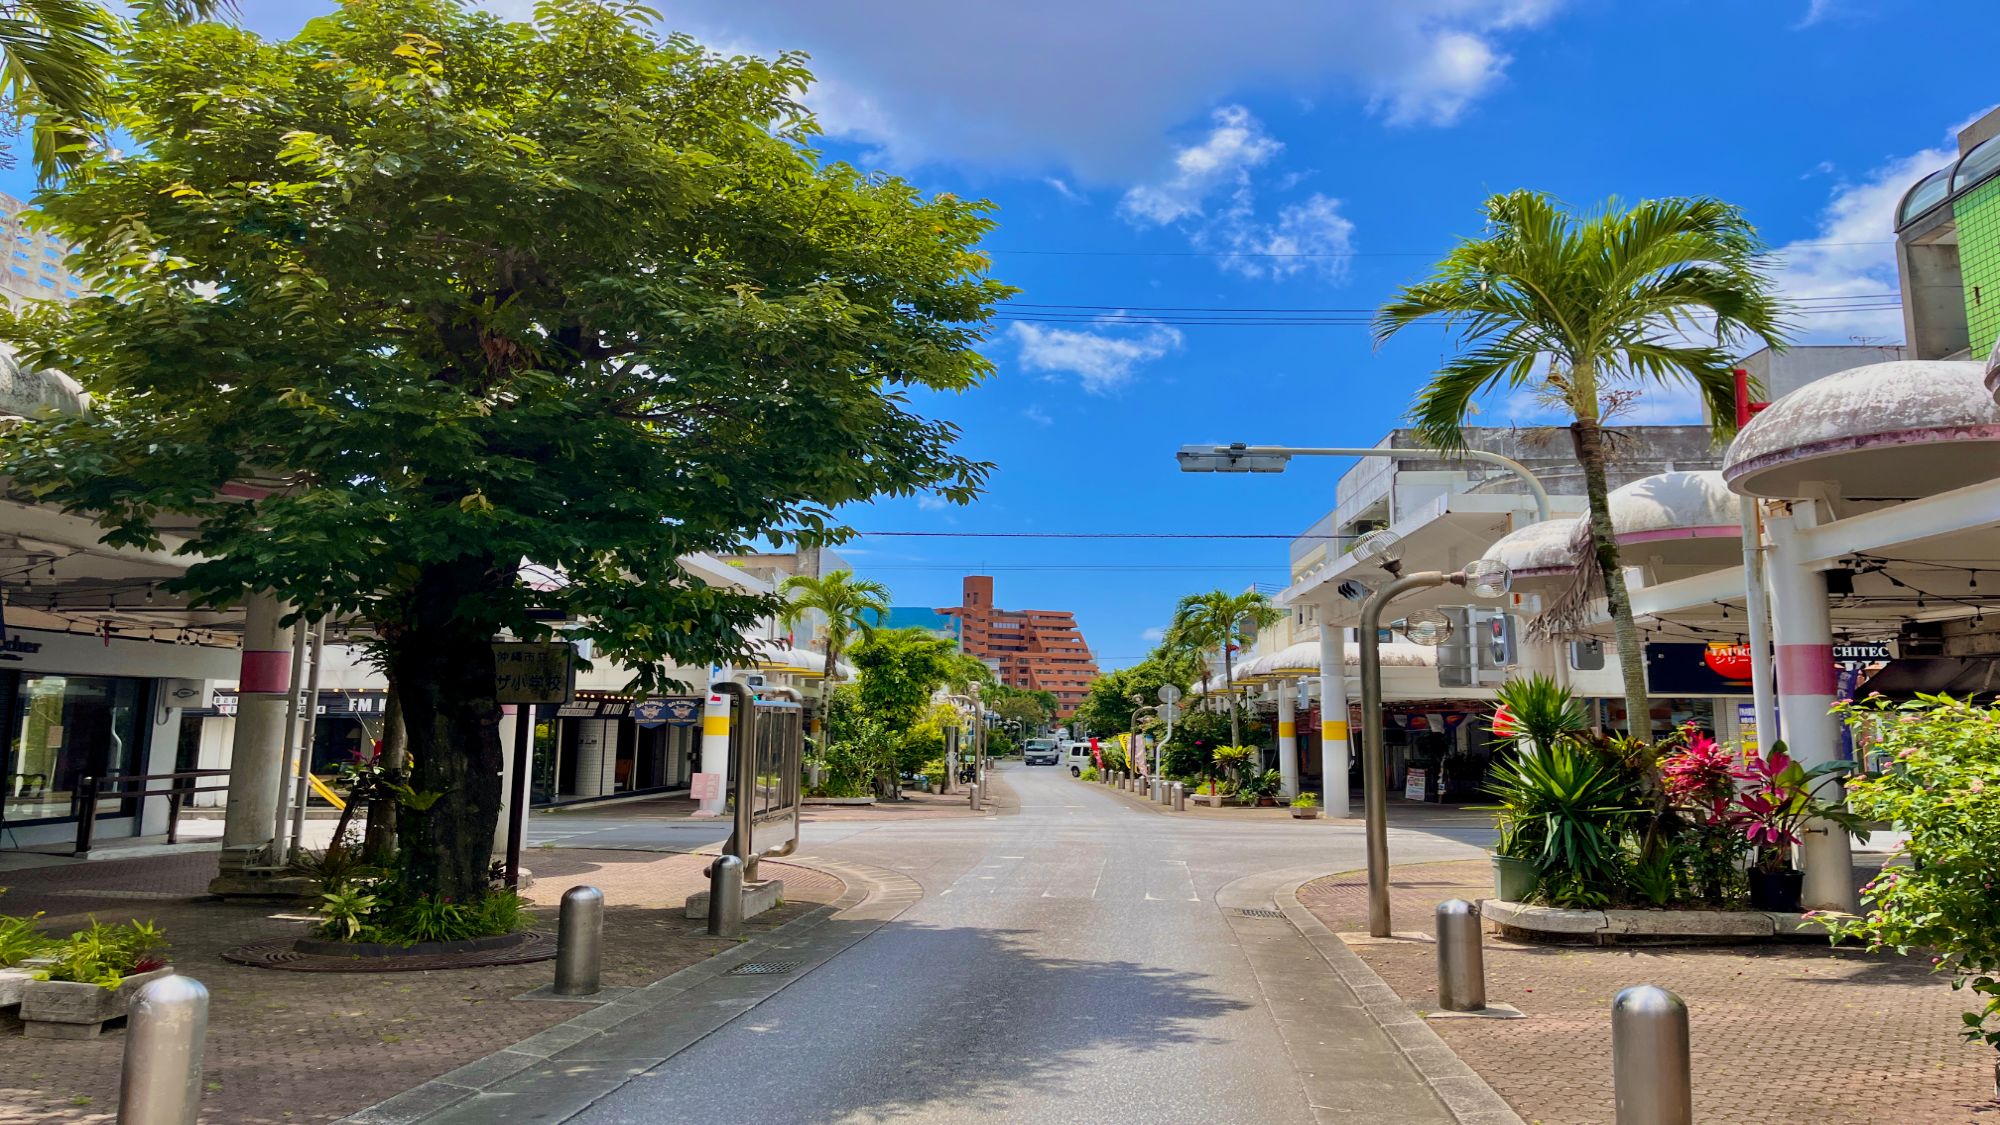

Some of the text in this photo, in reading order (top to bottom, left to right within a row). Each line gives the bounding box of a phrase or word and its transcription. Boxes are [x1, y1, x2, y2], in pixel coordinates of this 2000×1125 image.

[1715, 656, 1752, 665] シリー
[348, 698, 373, 712] FM
